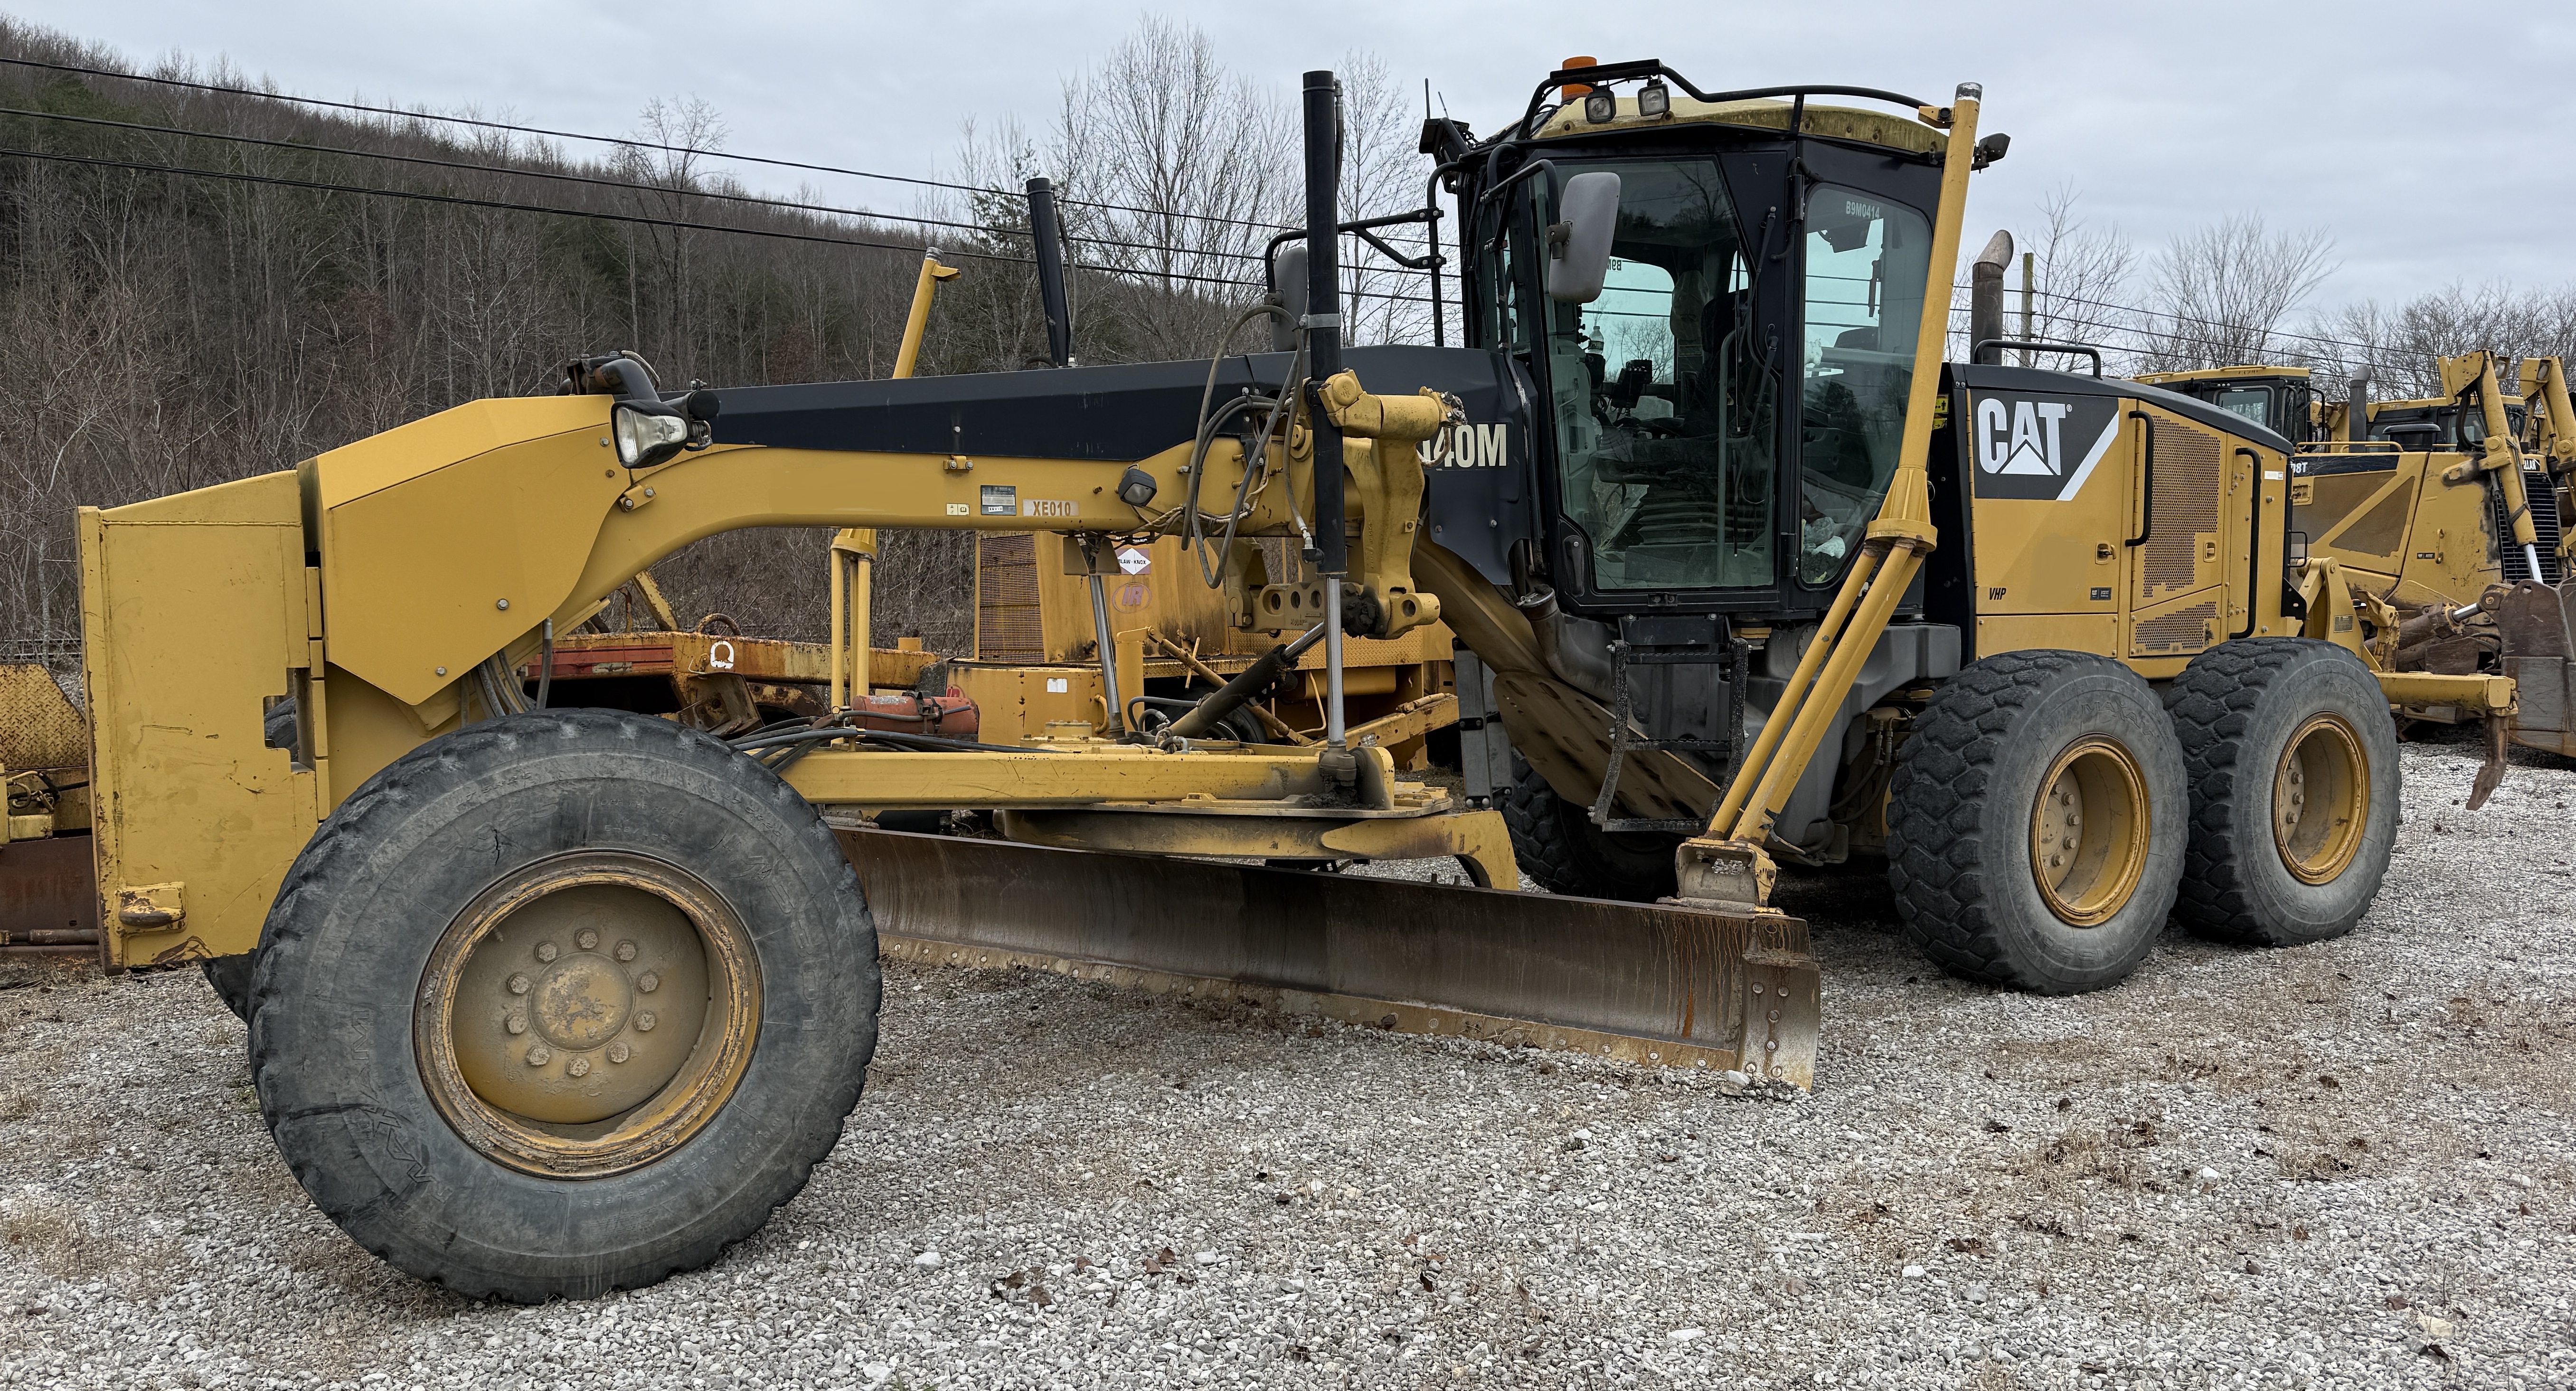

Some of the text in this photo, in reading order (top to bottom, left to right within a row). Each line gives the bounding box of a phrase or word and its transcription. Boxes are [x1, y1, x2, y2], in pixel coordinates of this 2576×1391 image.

[1846, 200, 1880, 219] B9M0414
[1978, 398, 2066, 475] CAT
[1033, 501, 1071, 516] XE010
[1990, 587, 2007, 600] VHP
